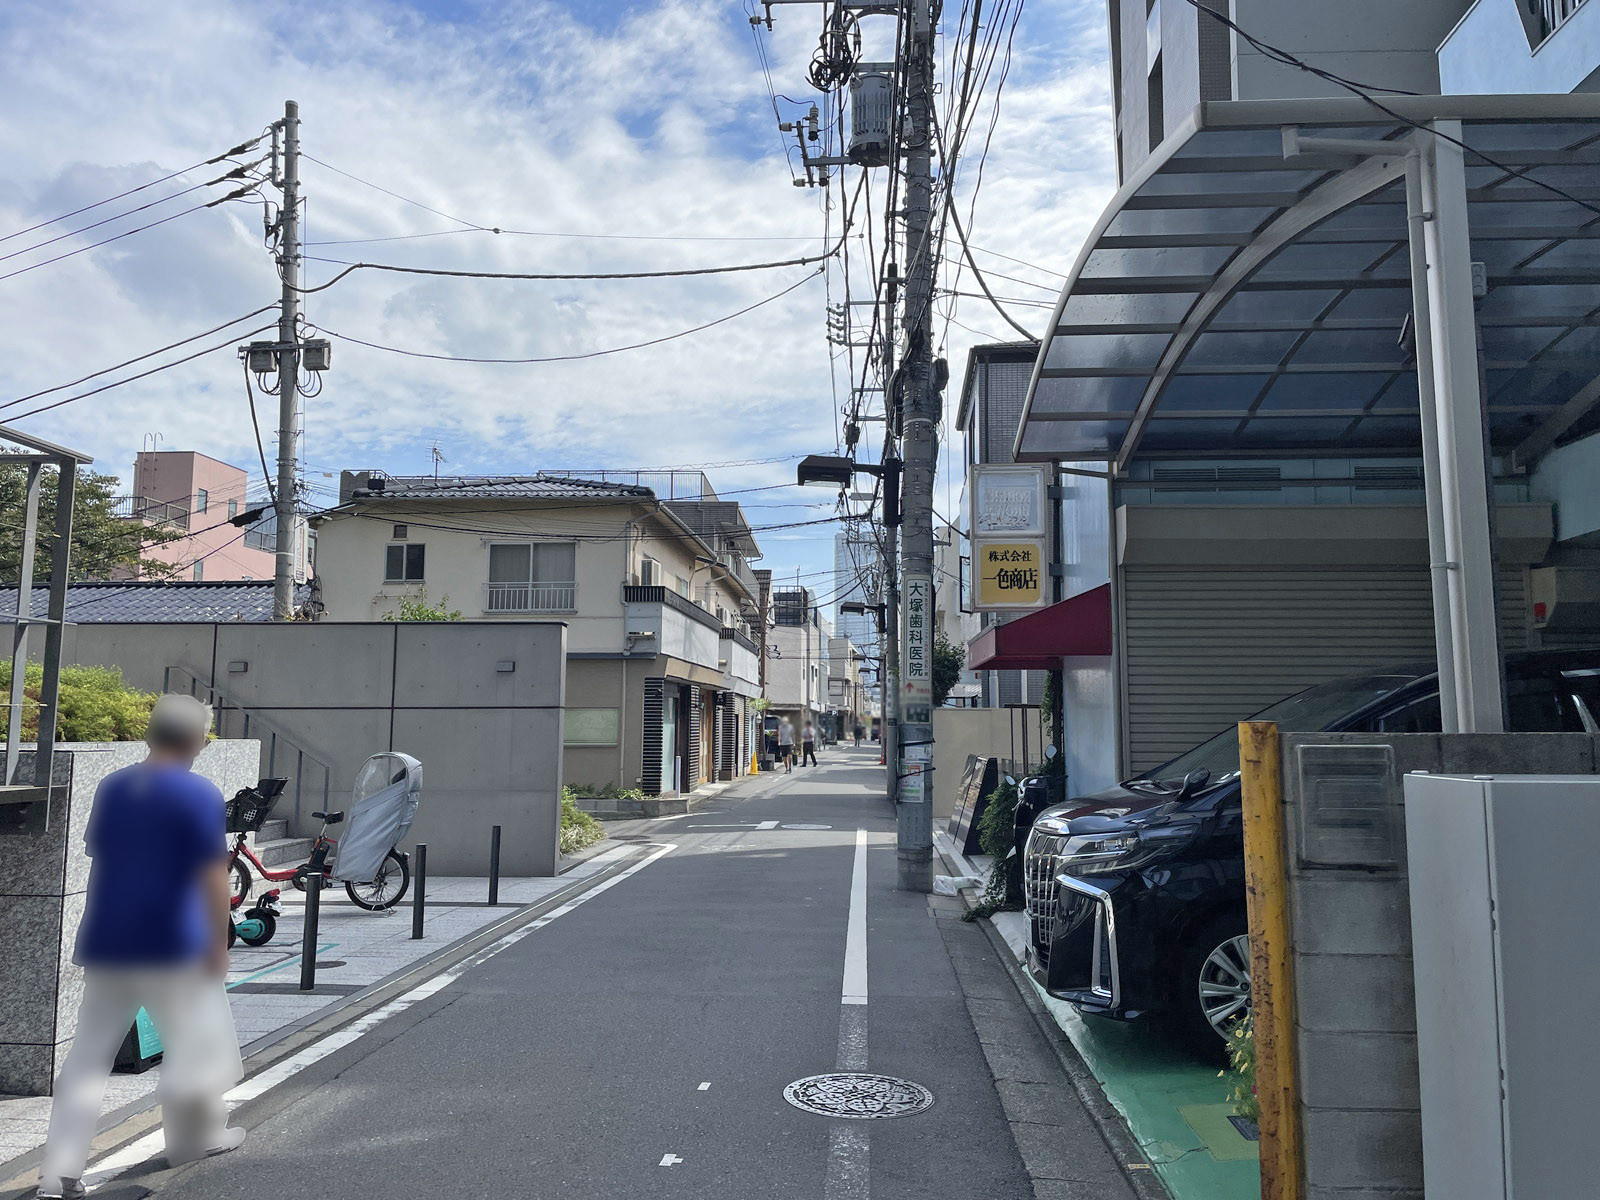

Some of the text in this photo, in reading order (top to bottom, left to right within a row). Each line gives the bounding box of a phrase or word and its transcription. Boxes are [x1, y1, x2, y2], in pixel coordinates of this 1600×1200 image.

[988, 550, 1032, 562] 株式会社
[982, 567, 1038, 590] 一色商店
[909, 582, 924, 677] 大塚歯科医院
